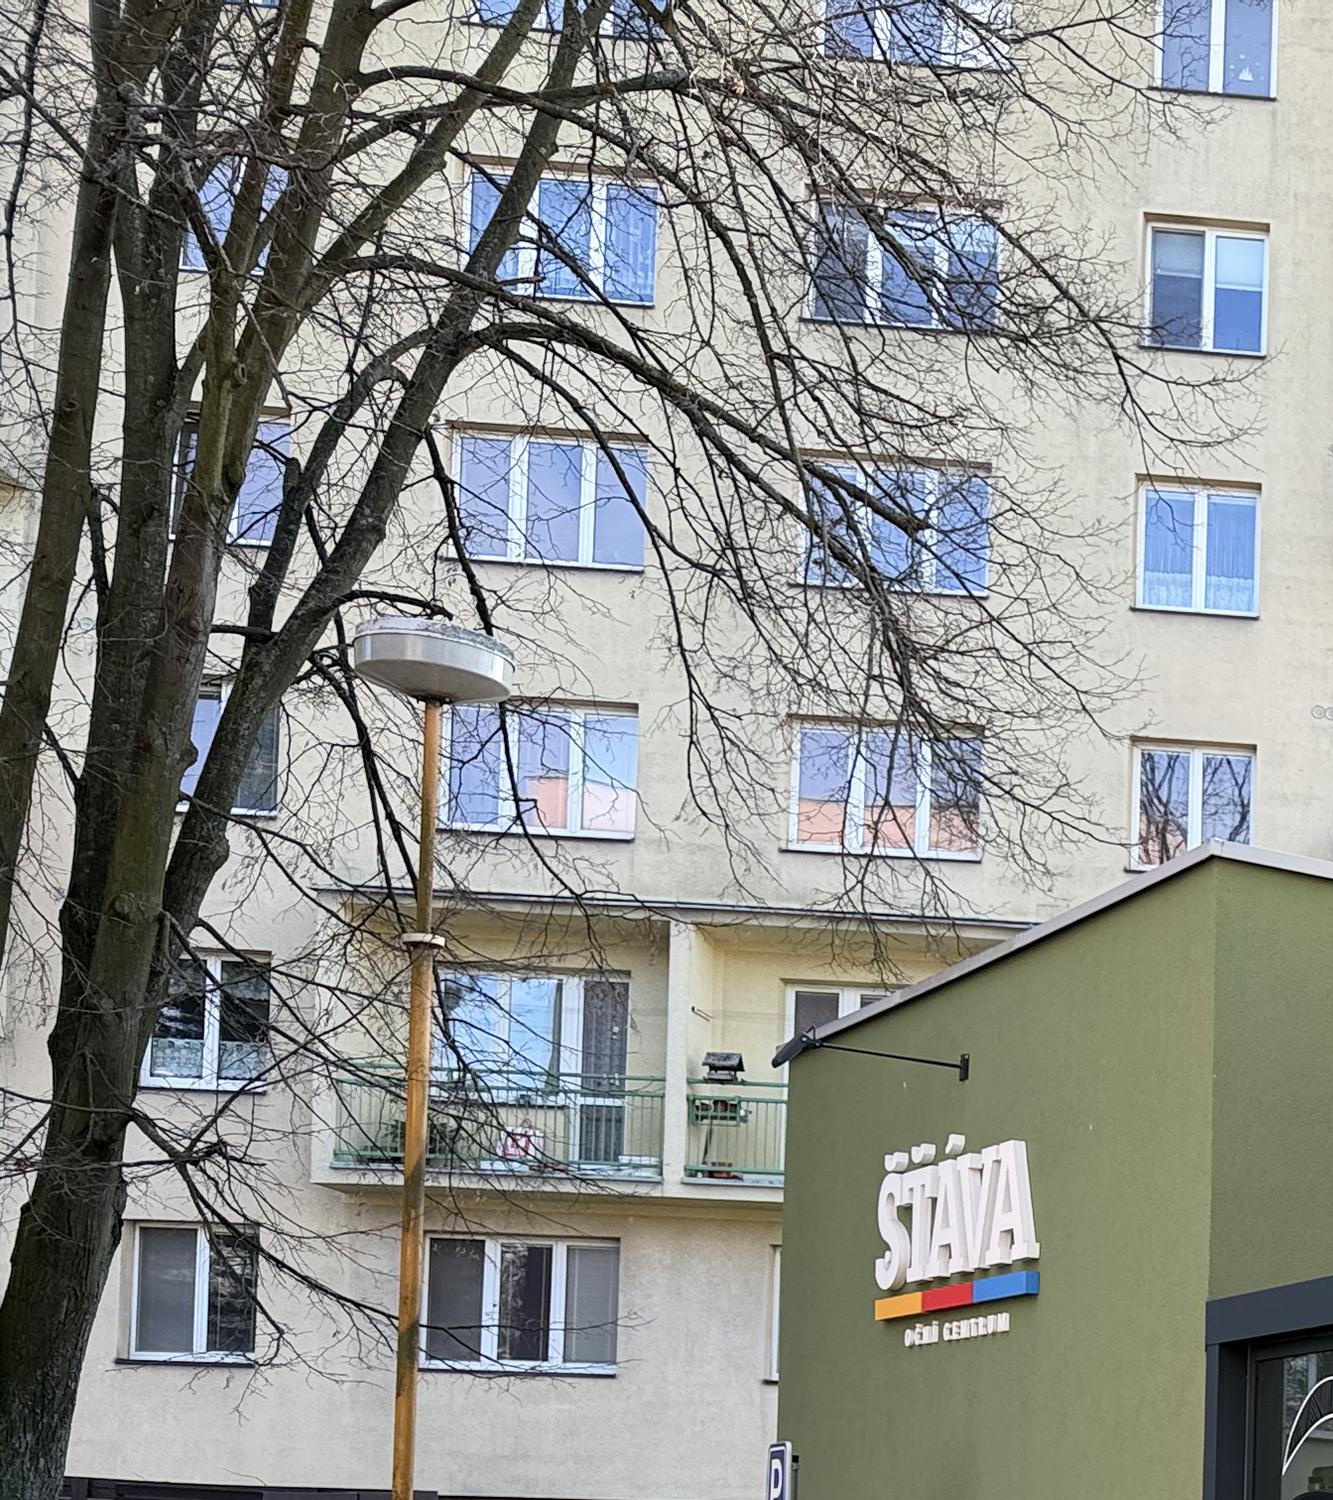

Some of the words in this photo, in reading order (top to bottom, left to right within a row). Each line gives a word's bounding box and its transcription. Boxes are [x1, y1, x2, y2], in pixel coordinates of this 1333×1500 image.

[875, 1134, 1041, 1291] ŠŤÁVA
[904, 1320, 939, 1347] OČNÍ
[943, 1312, 1010, 1342] CENTRUM
